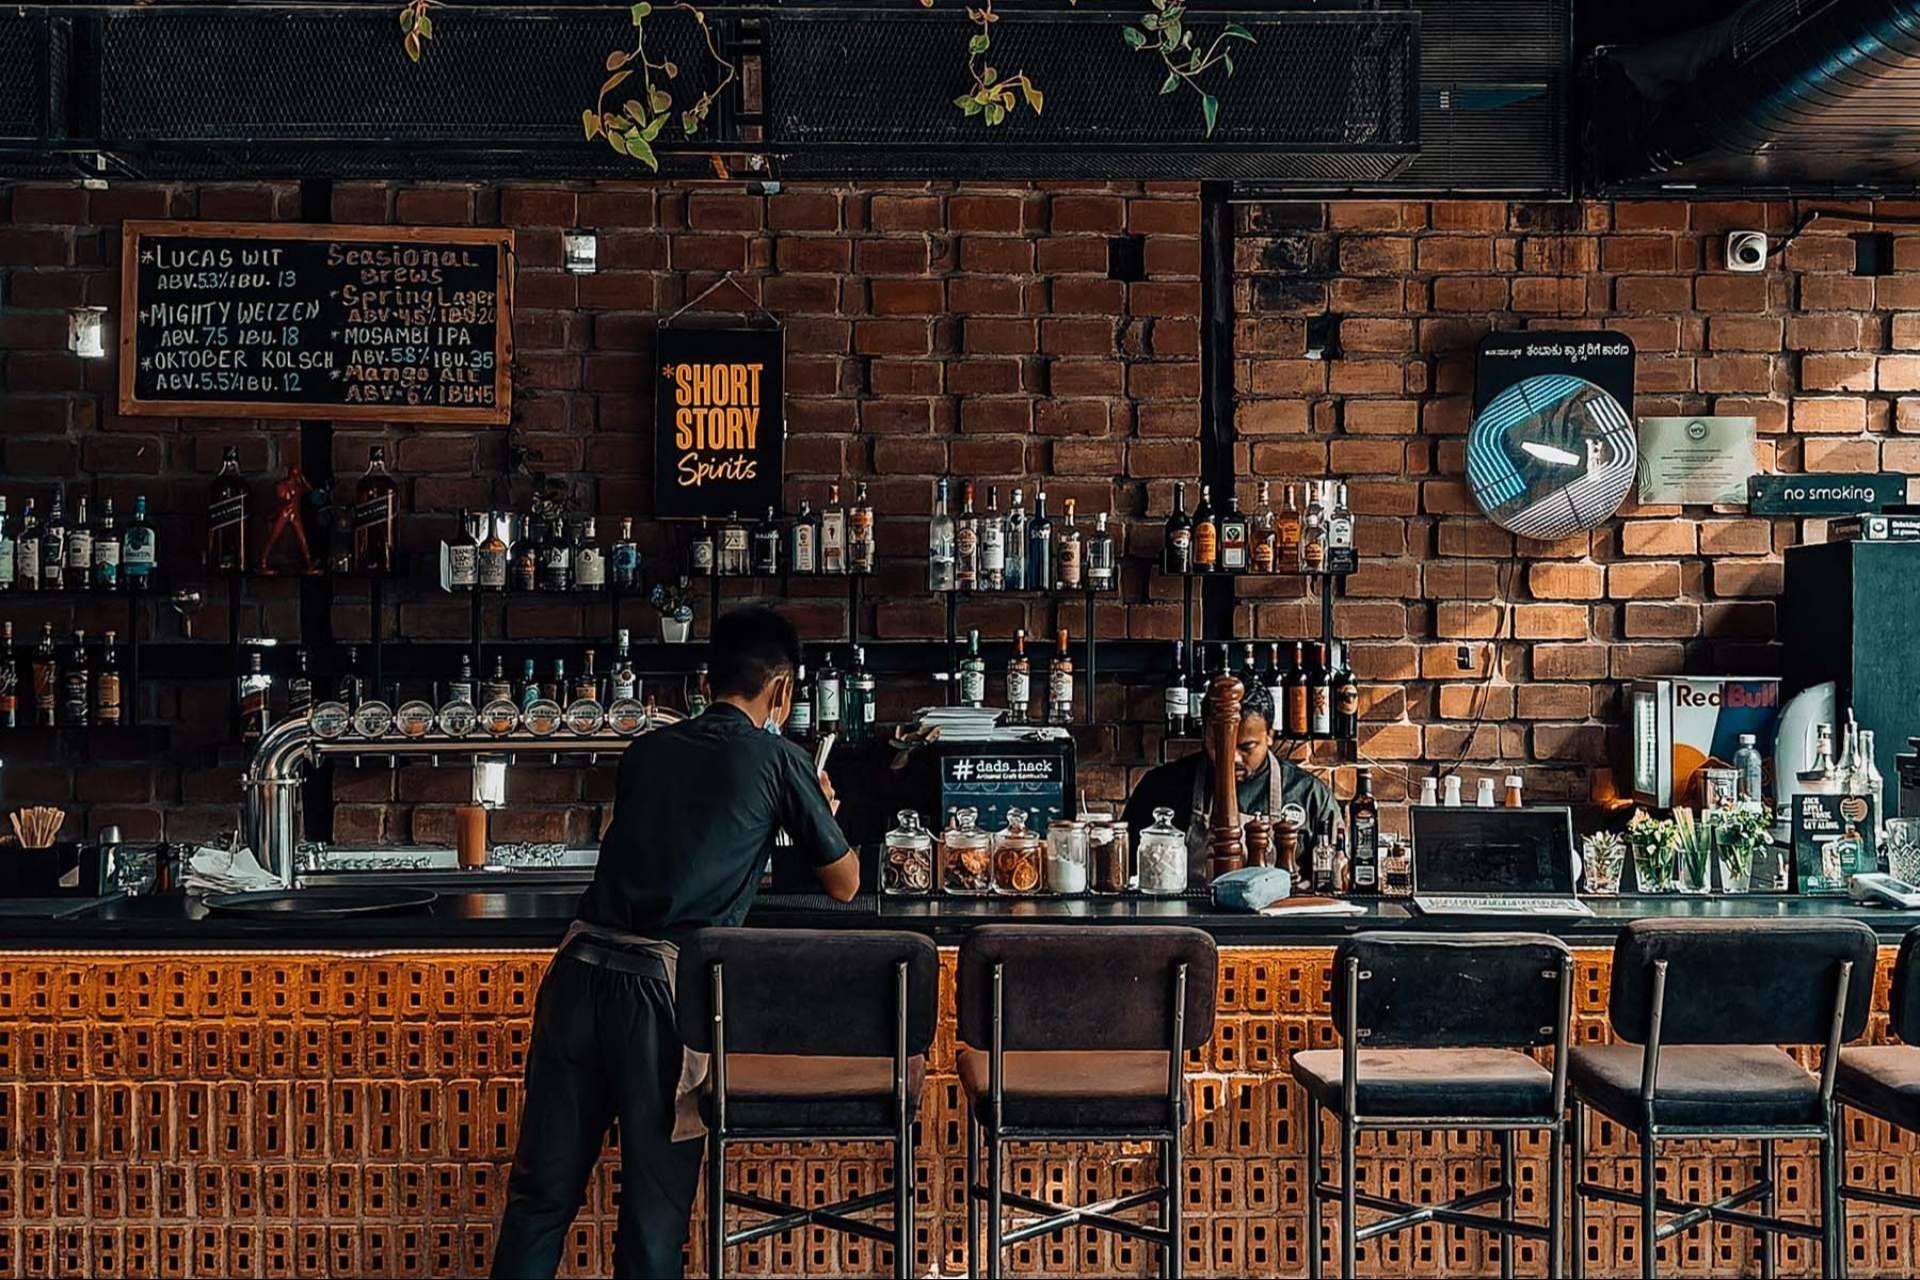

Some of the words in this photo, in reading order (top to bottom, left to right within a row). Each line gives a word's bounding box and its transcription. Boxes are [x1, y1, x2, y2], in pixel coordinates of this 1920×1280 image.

[157, 245, 234, 269] LUCAS
[242, 249, 283, 267] WIT
[277, 270, 297, 288] 13
[150, 301, 232, 328] MIGHTY
[237, 300, 320, 325] WEIZEN
[281, 326, 300, 346] 18
[343, 326, 429, 346] MOSAMBI
[436, 327, 472, 346] IPA
[154, 349, 248, 370] OKTOBER
[261, 350, 334, 369] KOLSCH
[283, 373, 303, 392] 12
[675, 363, 763, 406] SHORT
[675, 407, 760, 450] STORY
[677, 452, 758, 487] Spirits
[1784, 488, 1805, 500] no
[1808, 484, 1875, 503] smoking
[1677, 683, 1724, 708] Red
